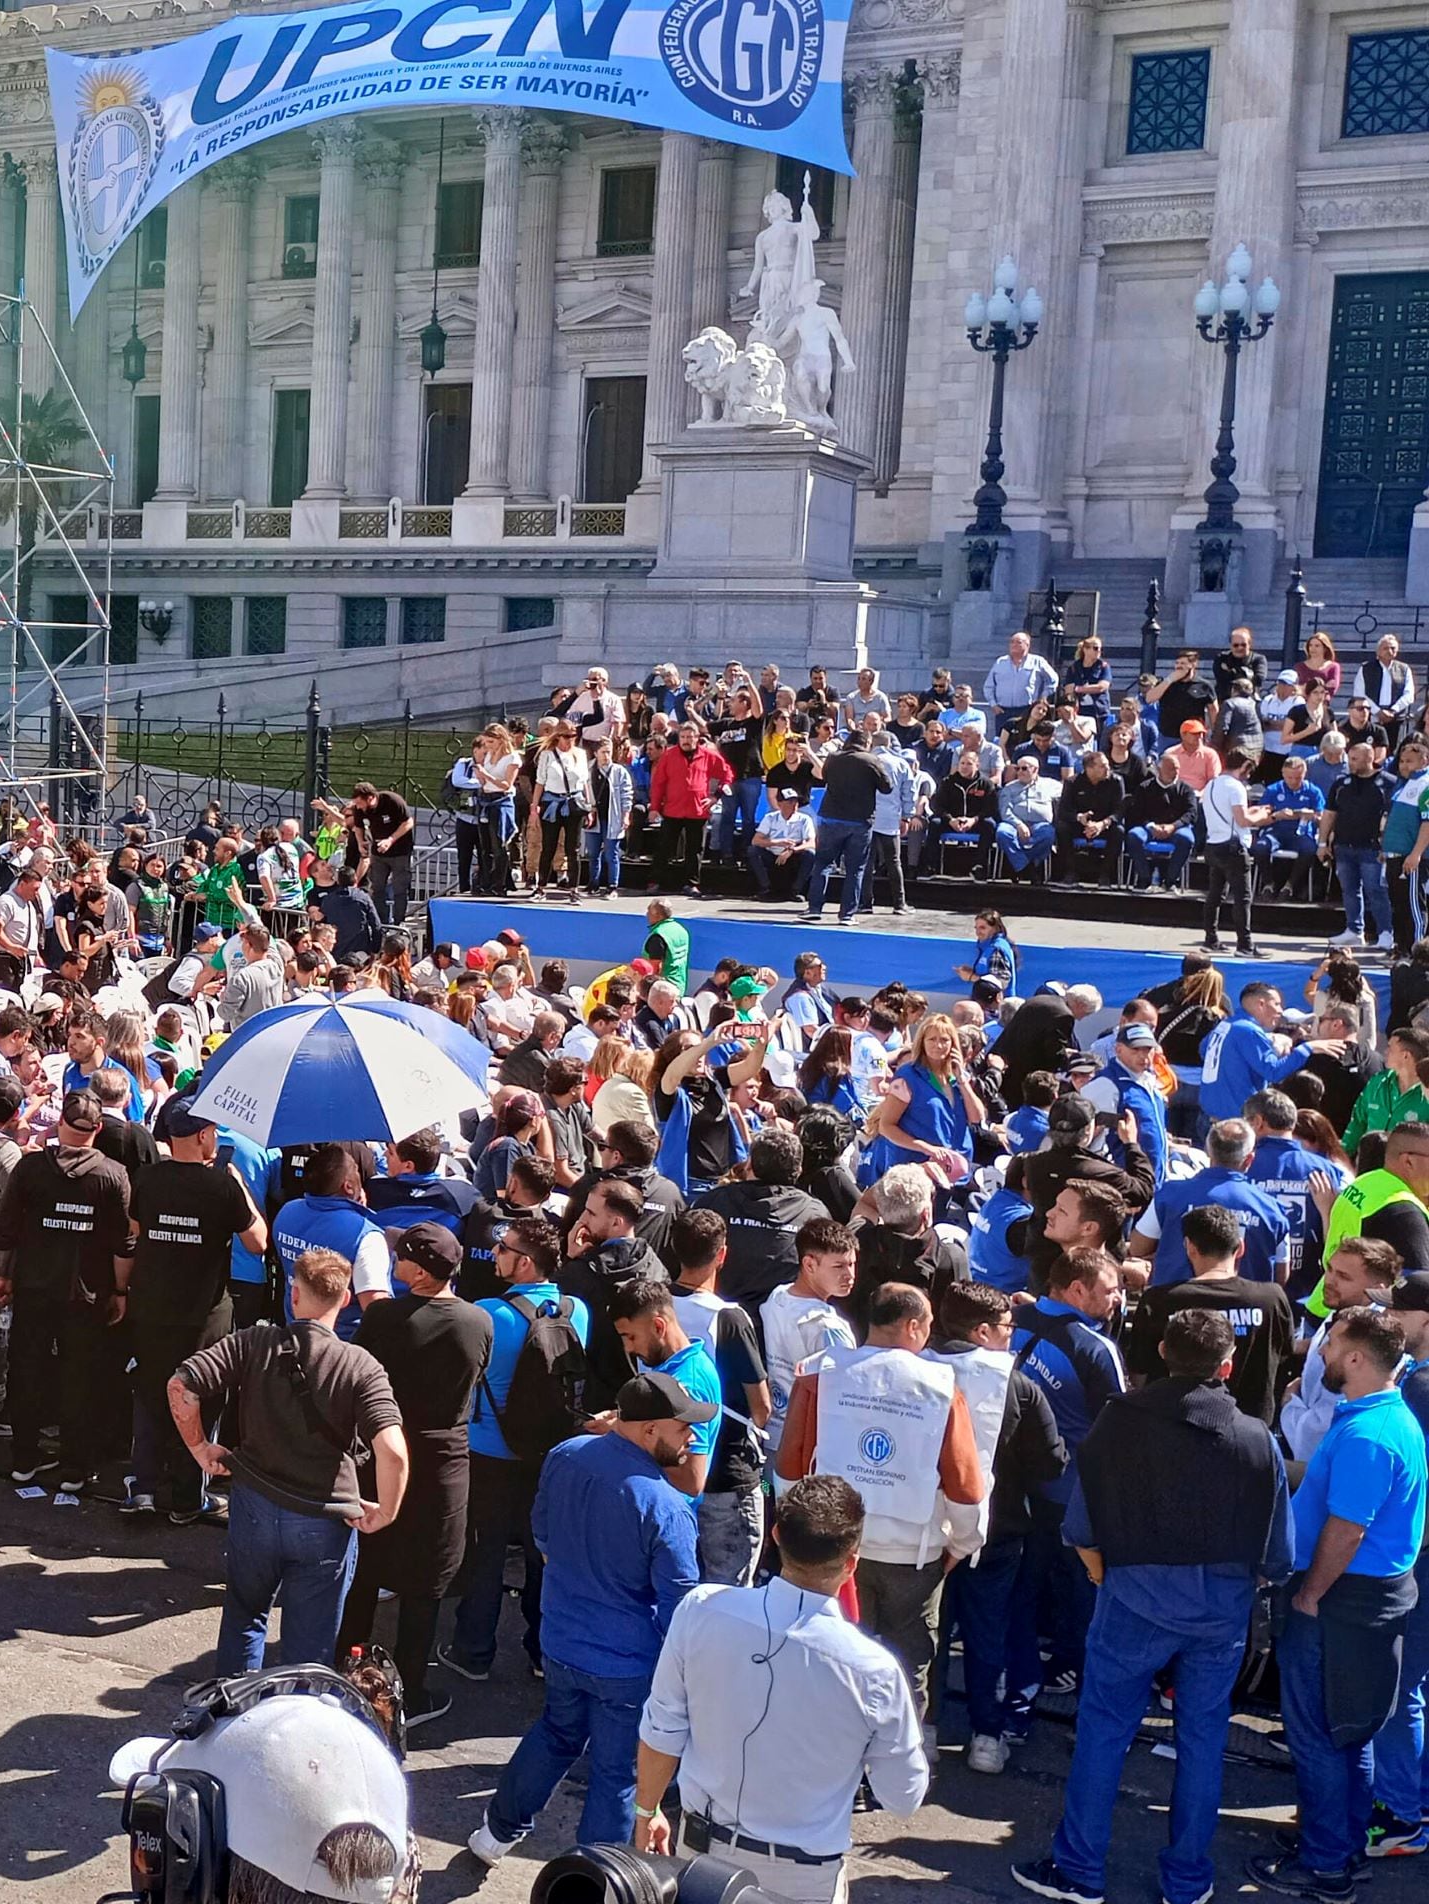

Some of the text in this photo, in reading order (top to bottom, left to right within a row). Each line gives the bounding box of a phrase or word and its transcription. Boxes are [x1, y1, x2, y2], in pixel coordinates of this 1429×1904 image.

[190, 0, 632, 126] UPCN
[341, 67, 394, 86] NACIONALES
[423, 62, 470, 72] GOBIERNO
[500, 60, 536, 69] CIUDAD
[553, 62, 592, 73] BUENOS
[594, 67, 623, 77] AIRES
[788, 24, 819, 109] TRABAJO
[205, 79, 413, 156] RESPONSABILIDAD
[419, 76, 452, 91] DE
[458, 75, 508, 90] SER
[732, 109, 762, 127] R.A.
[213, 1094, 257, 1125] CAPITAL
[223, 1085, 258, 1111] FILIAL
[729, 1216, 742, 1225] LA
[135, 1829, 163, 1854] Telex
